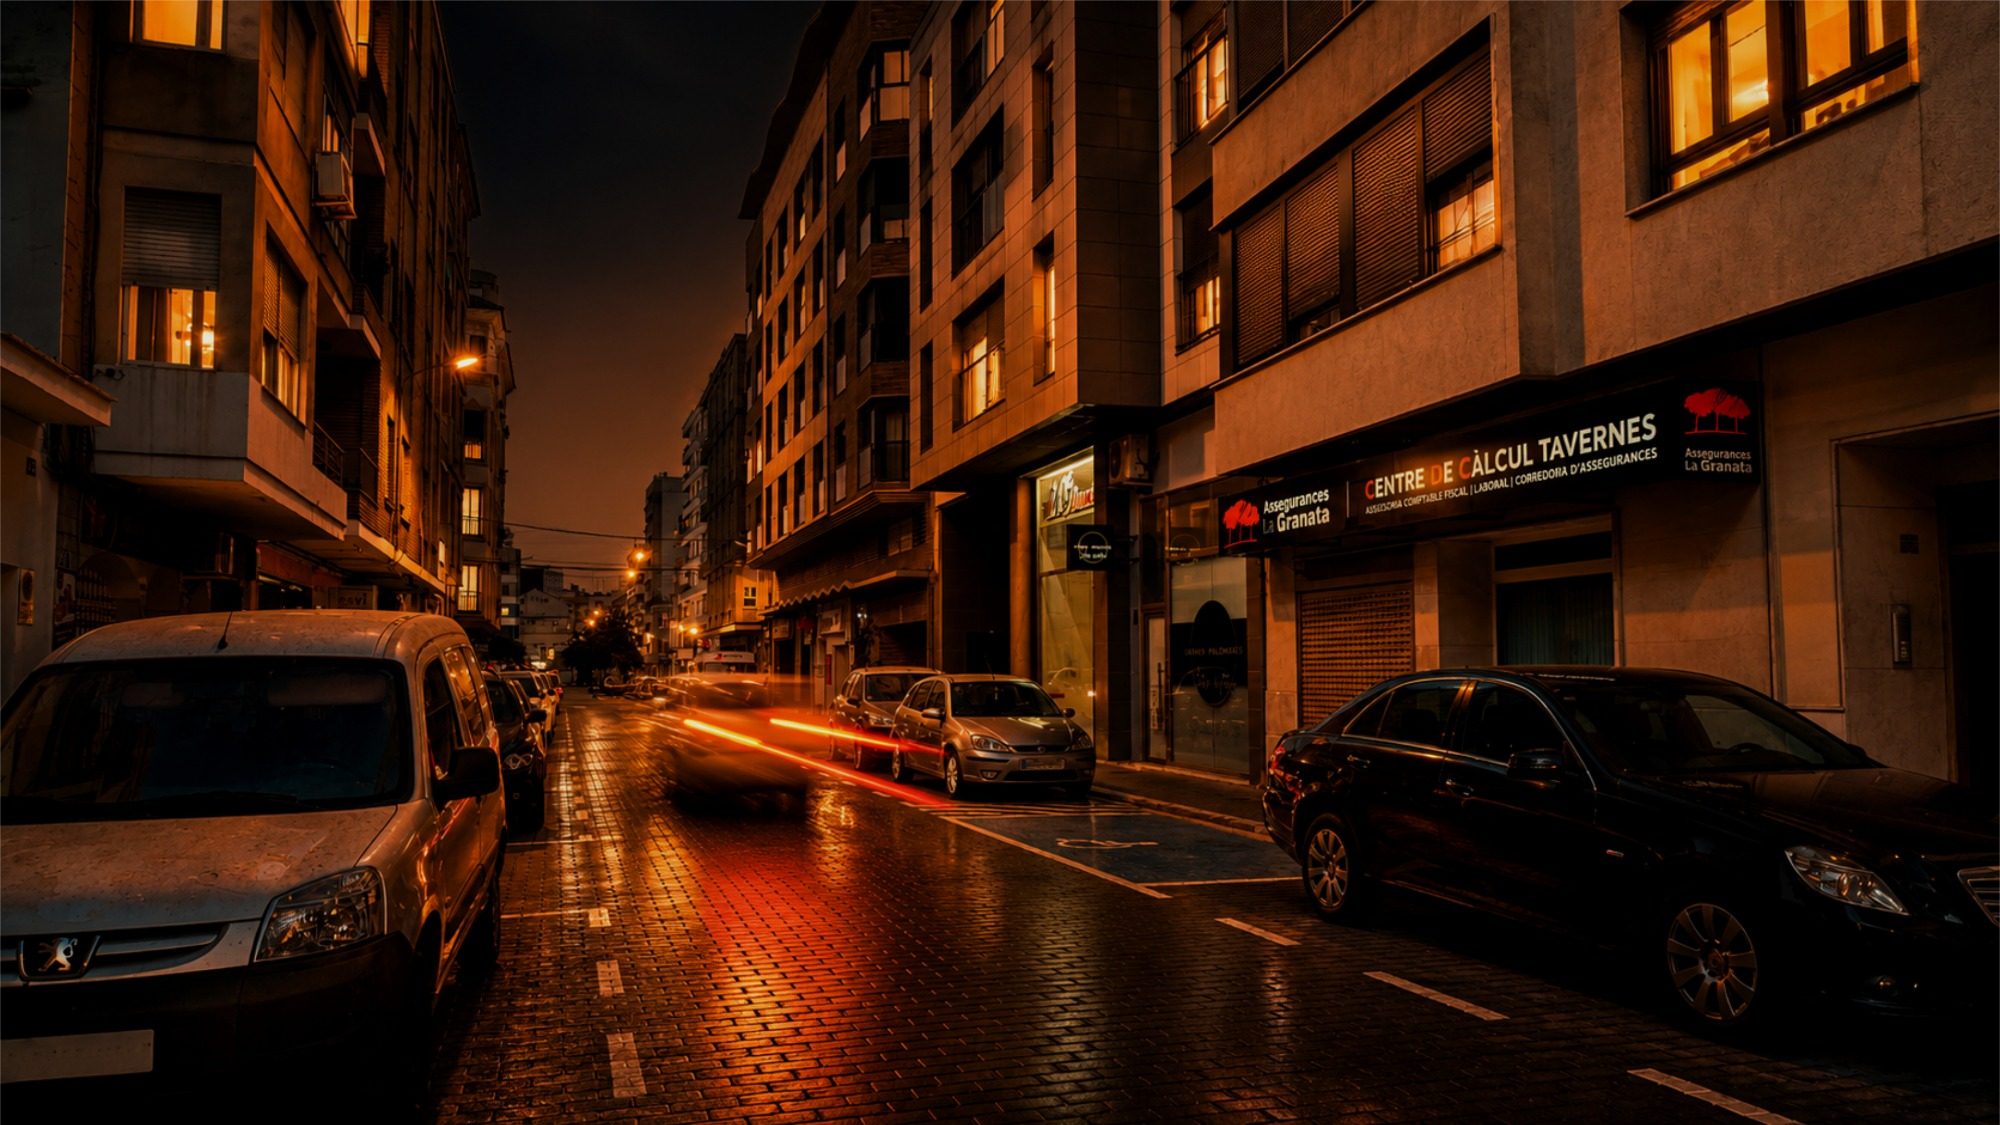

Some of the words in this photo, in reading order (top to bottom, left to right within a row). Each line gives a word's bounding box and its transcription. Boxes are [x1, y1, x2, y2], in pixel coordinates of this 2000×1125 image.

[1364, 467, 1425, 500] CENTRE
[1431, 458, 1454, 486] DE
[1458, 443, 1534, 480] CÀLCUL
[1538, 412, 1658, 463] TAVERNES
[1684, 447, 1752, 460] Assegurances
[1684, 460, 1698, 472] La
[1701, 460, 1753, 473] Granata
[1474, 476, 1509, 495] LABORAL
[1569, 446, 1659, 474] D'ASSEGURANCES
[1263, 488, 1330, 515] Assegurances
[1262, 517, 1275, 535] La
[1276, 506, 1330, 533] Granata
